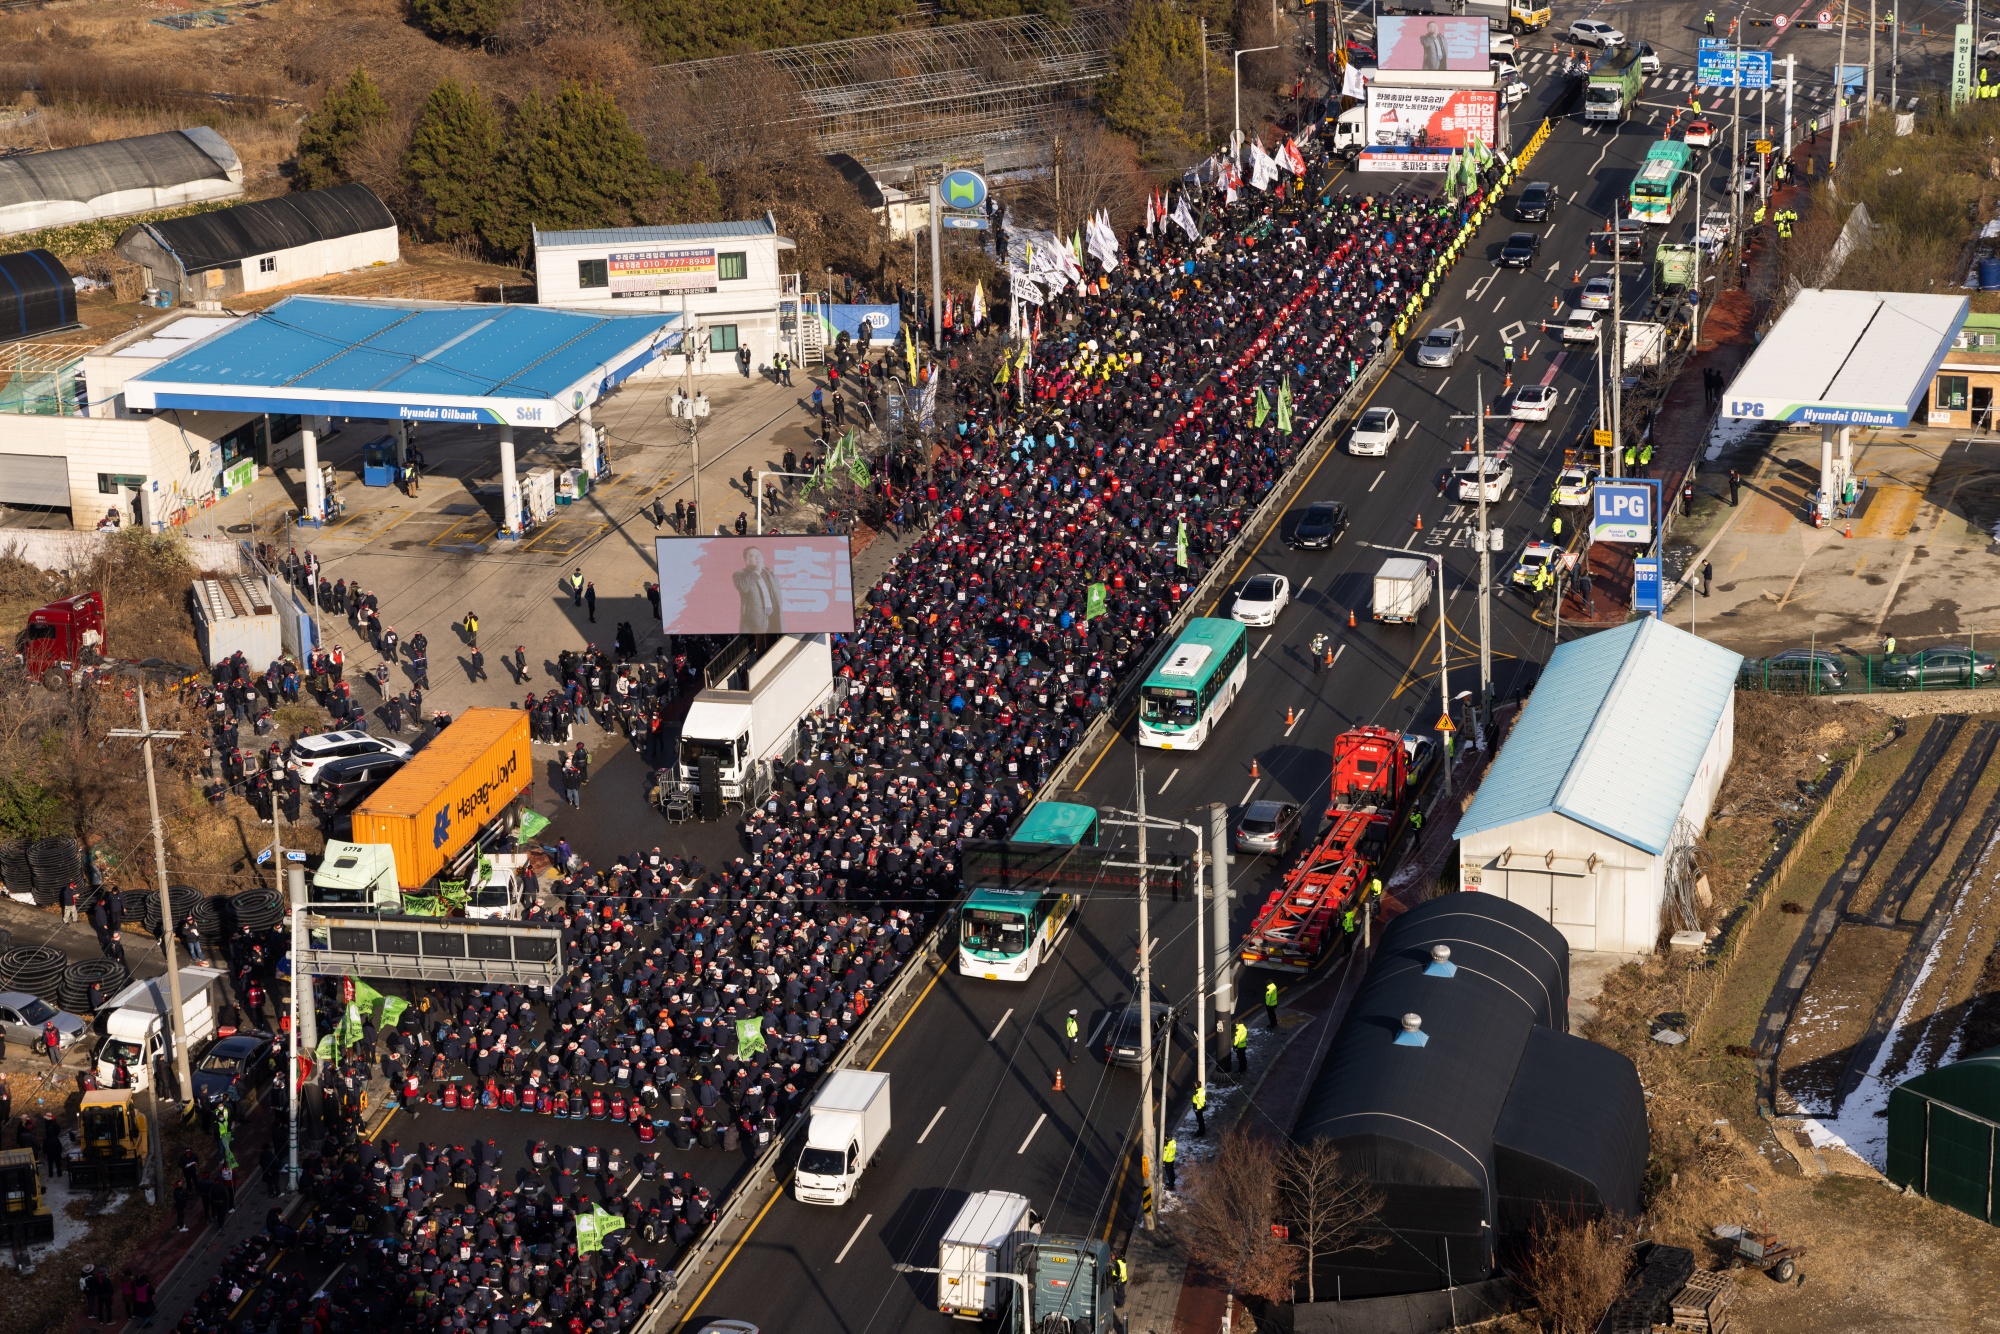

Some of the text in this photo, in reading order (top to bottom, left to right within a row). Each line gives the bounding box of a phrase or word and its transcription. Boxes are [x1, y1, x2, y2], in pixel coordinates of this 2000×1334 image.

[1376, 93, 1444, 104] 화물총파업 투쟁승리!
[1454, 103, 1494, 117] 총파업
[1441, 117, 1494, 131] 총력투쟁
[1467, 130, 1494, 143] 대회
[643, 257, 711, 268] 010-7777-8949
[865, 315, 886, 325] Self
[400, 407, 478, 421] Hyundai Oilbank
[516, 406, 542, 421] Self
[1731, 402, 1764, 417] LPG
[1804, 409, 1893, 425] Hyundai Oilbank
[1599, 494, 1644, 517] LPG
[1164, 688, 1173, 696] 52
[456, 750, 517, 824] Hapag-Lloyd
[982, 867, 999, 876] 부곡
